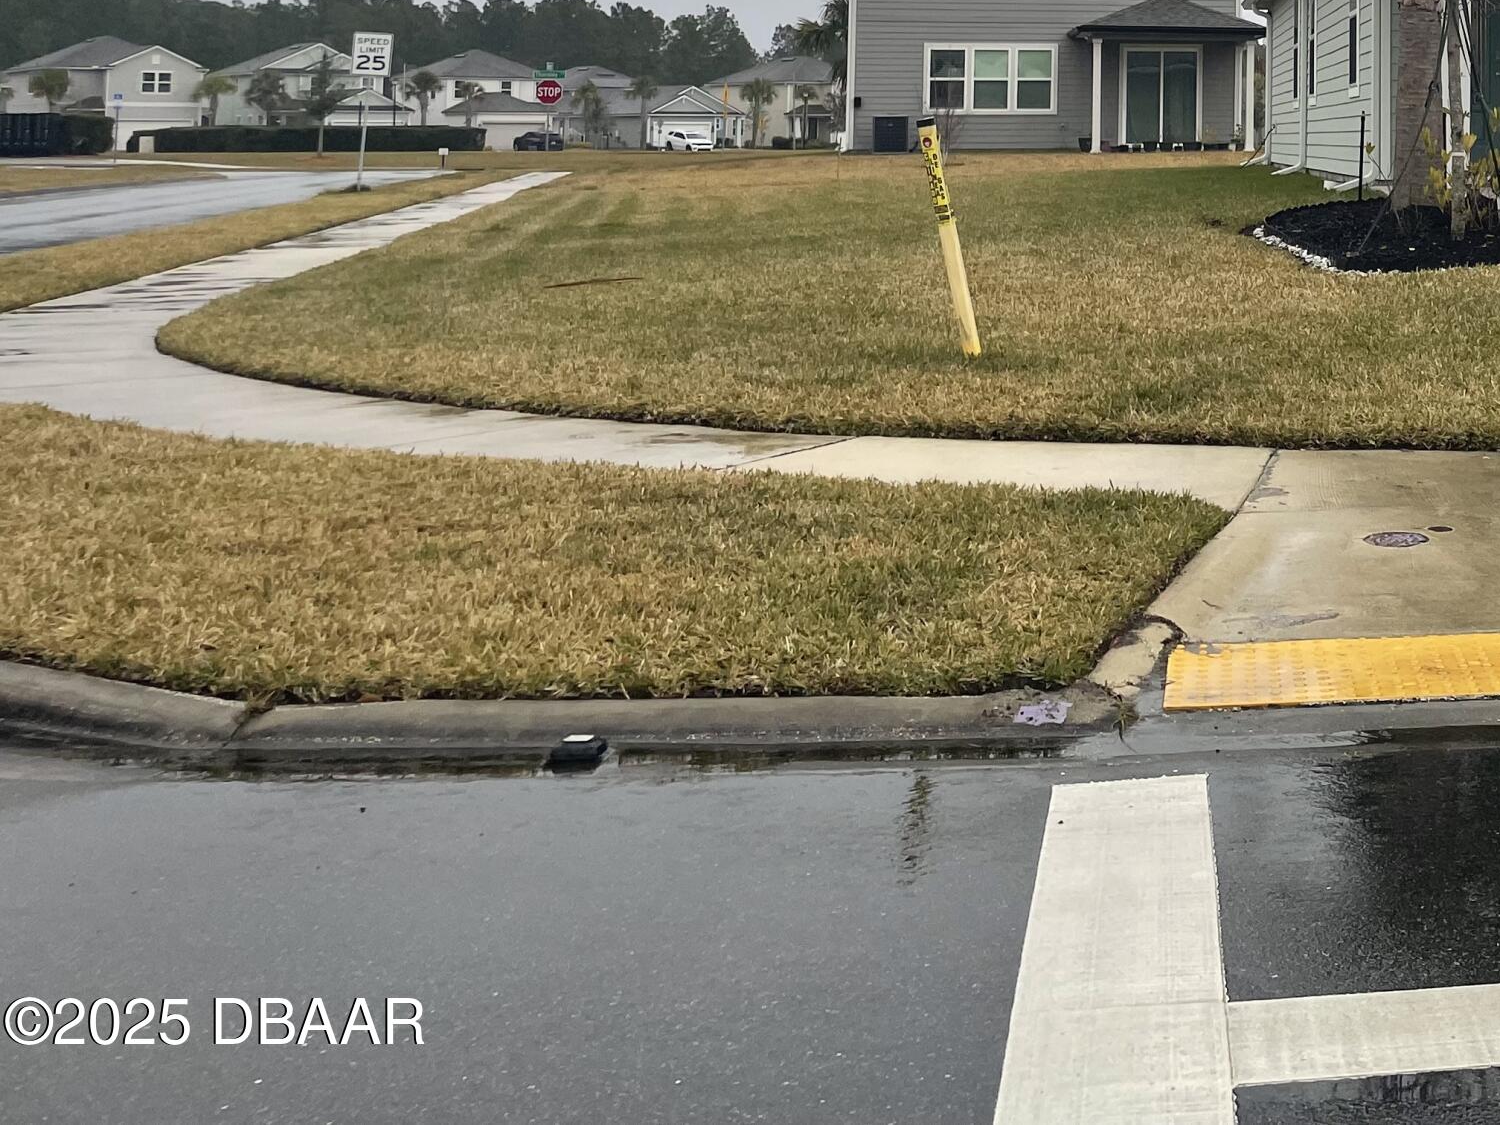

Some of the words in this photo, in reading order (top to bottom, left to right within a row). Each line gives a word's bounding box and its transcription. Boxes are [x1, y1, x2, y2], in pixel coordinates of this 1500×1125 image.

[357, 37, 390, 46] SPEED
[356, 55, 386, 71] 25
[537, 86, 561, 97] STOP
[932, 153, 938, 168] DE
[937, 177, 946, 200] GAS
